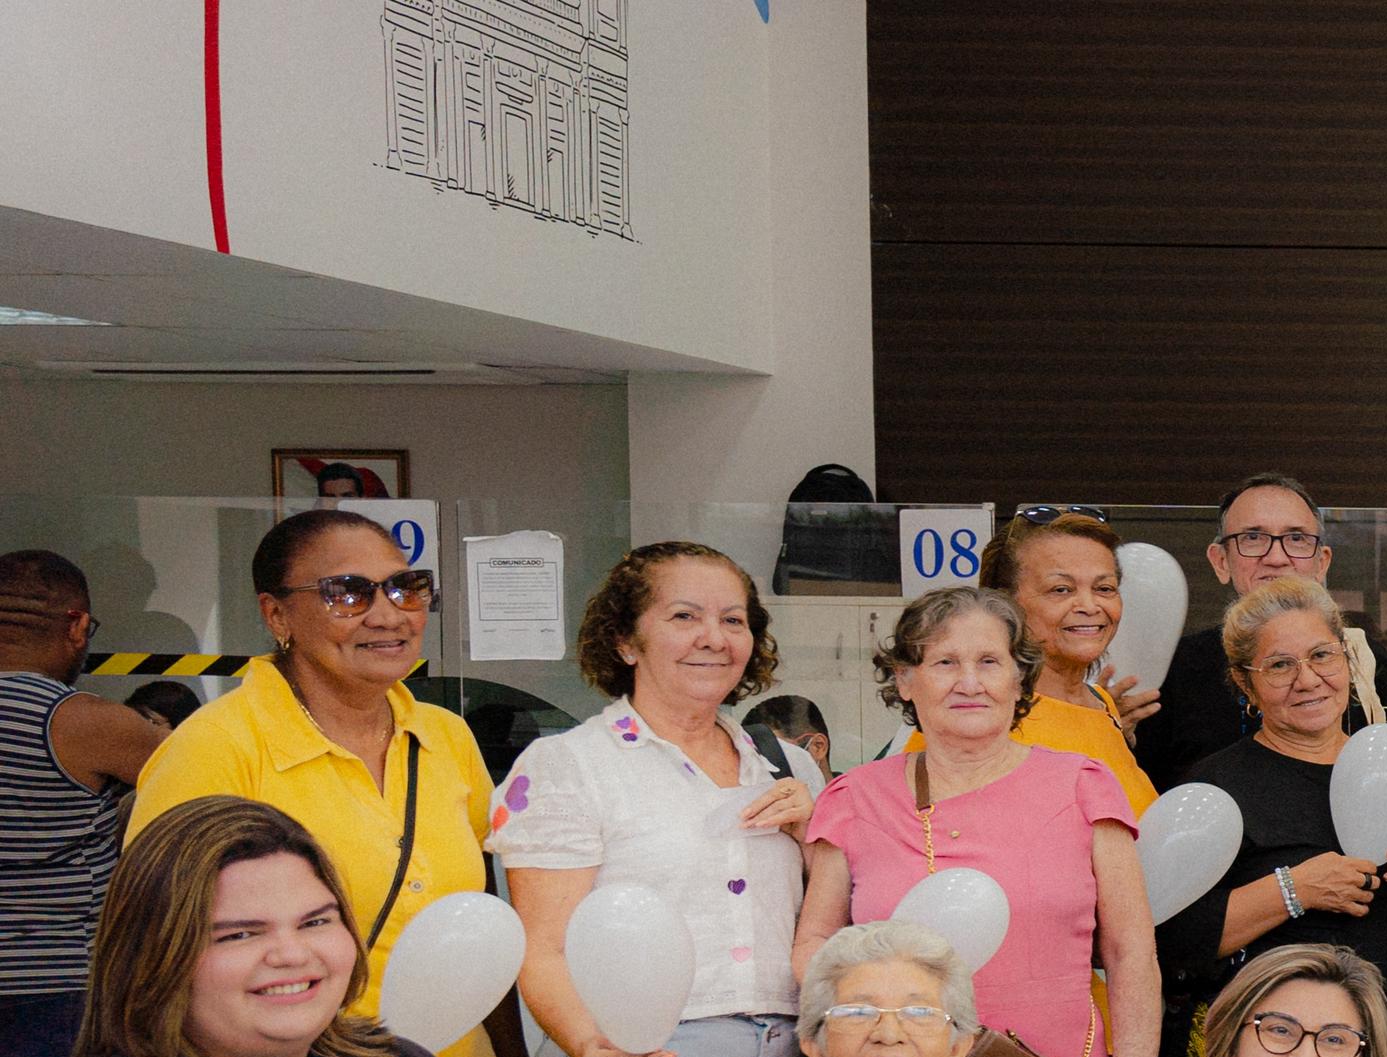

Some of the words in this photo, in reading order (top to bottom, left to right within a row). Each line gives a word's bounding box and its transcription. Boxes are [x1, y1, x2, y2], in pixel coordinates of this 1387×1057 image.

[391, 519, 425, 567] 9
[491, 559, 542, 567] COMUNICADO
[913, 528, 980, 578] 08
